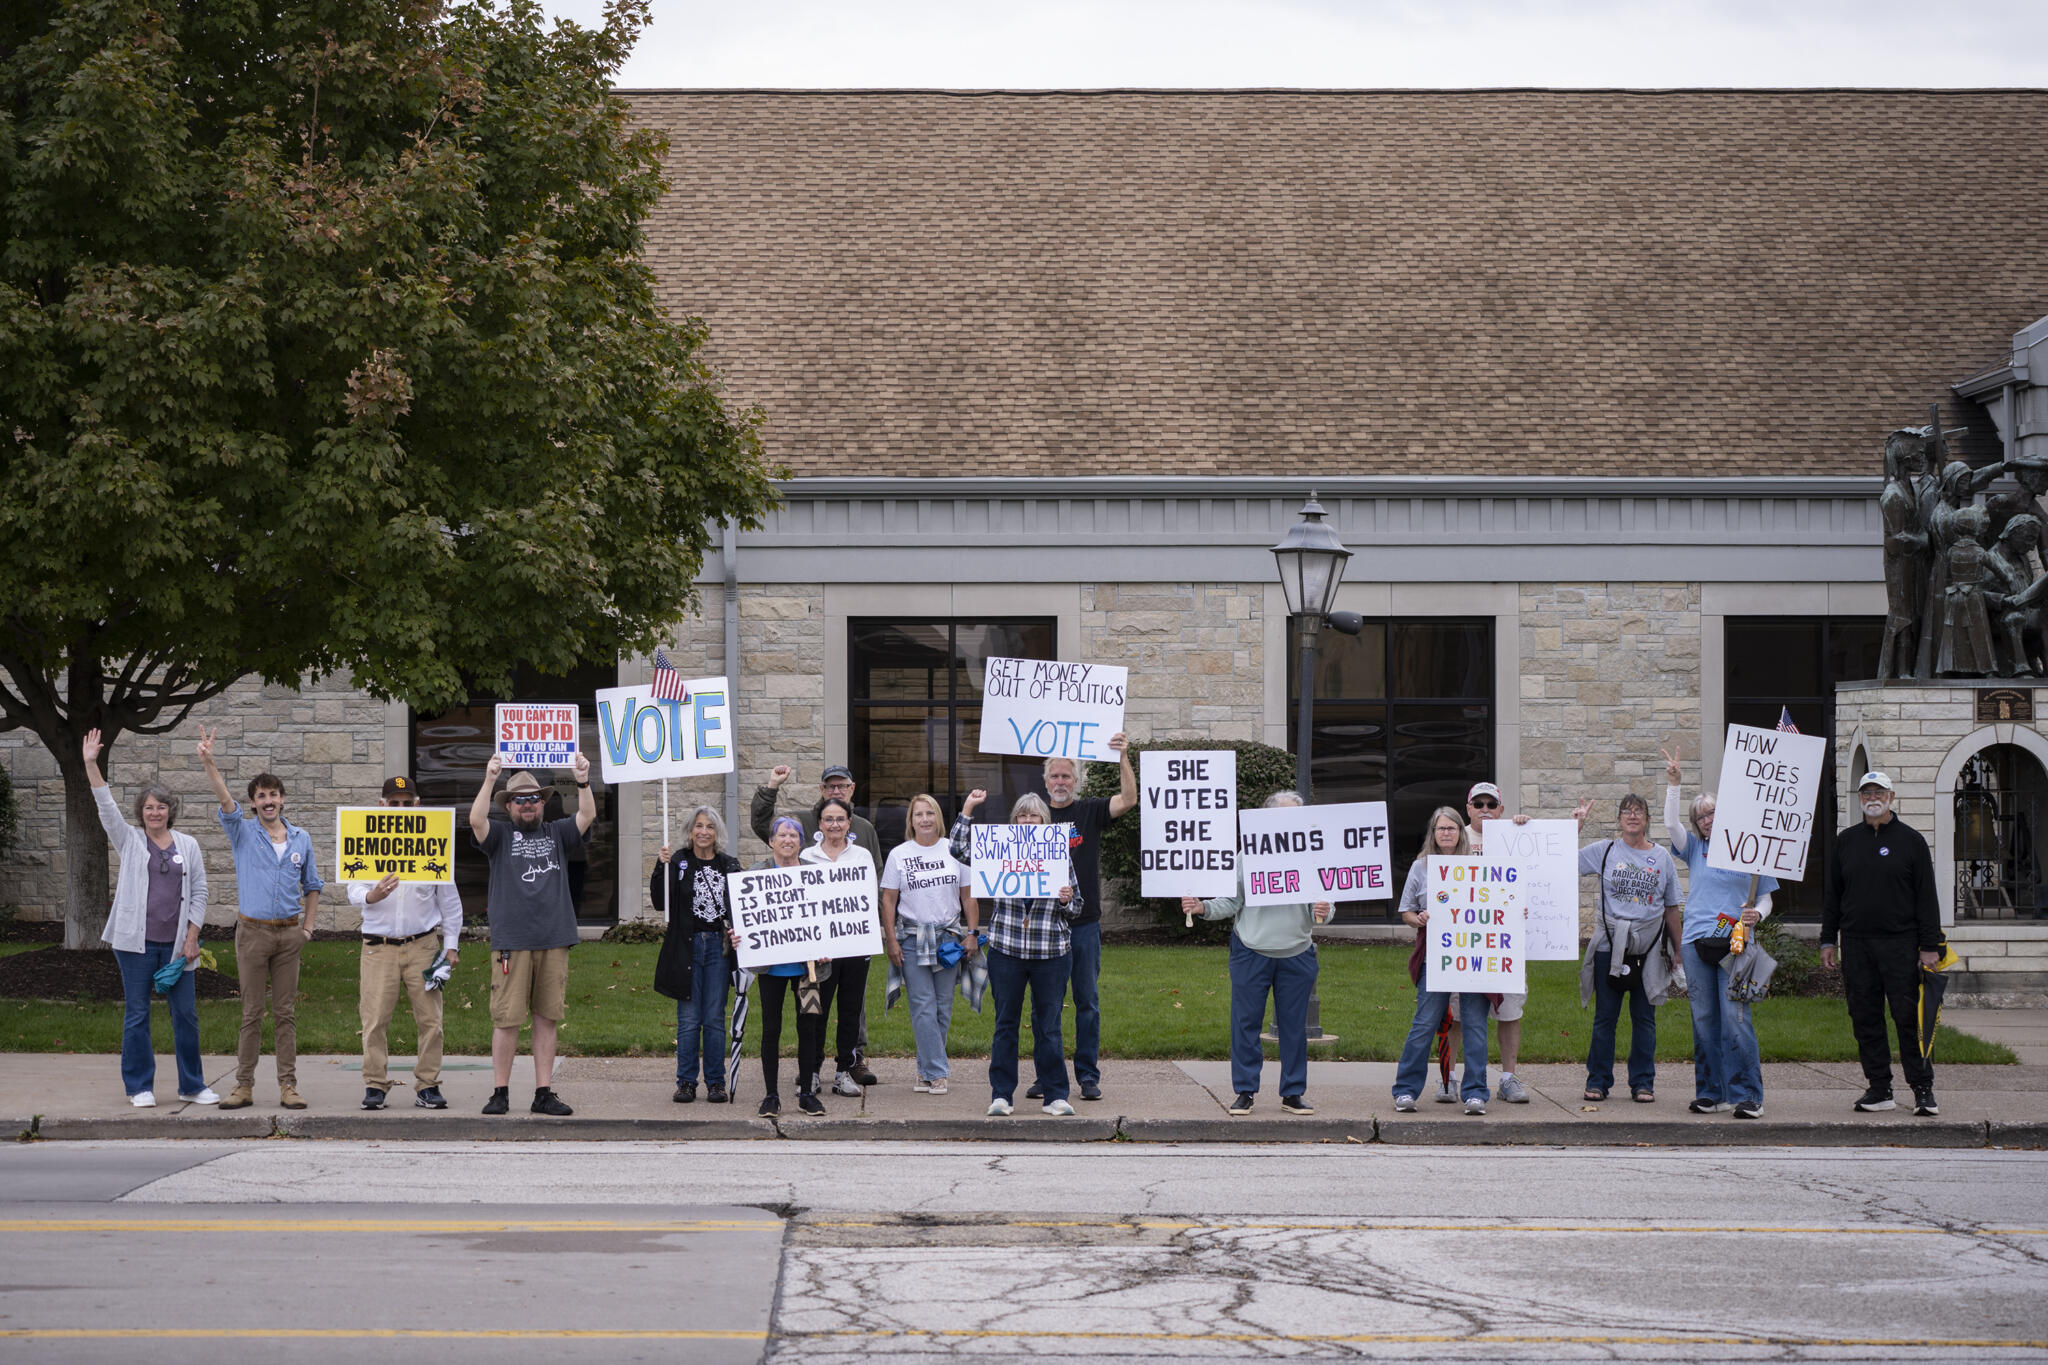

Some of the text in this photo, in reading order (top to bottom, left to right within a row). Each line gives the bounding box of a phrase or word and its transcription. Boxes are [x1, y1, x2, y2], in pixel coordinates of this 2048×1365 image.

[990, 659, 1092, 683] GET MONEY
[988, 676, 1124, 706] OUT OF POLITICS
[503, 709, 572, 722] YOU CAN'T FIX
[501, 722, 573, 741] STUPID
[599, 691, 726, 766] VOTE
[1008, 717, 1099, 759] VOTE
[507, 742, 567, 751] BUT YOU CAN
[1735, 730, 1778, 755] HOW
[537, 753, 546, 763] IT
[549, 753, 569, 763] OUT
[1168, 759, 1209, 781] SHE
[1745, 758, 1800, 784] DOES
[1148, 787, 1228, 810] VOTES
[1753, 782, 1798, 807] THIS
[366, 815, 427, 834] DEFEND
[1761, 808, 1813, 833] END?
[974, 825, 999, 842] WE
[1007, 825, 1038, 843] SINK
[1043, 825, 1067, 842] OR
[1165, 820, 1212, 843] SHE
[1243, 826, 1386, 855] HANDS OFF
[344, 837, 448, 856] DEMOCRACY
[974, 841, 1011, 860] SWIM
[1013, 841, 1068, 860] TOGETHER
[1501, 832, 1562, 857] VOTE
[375, 860, 416, 873] VOTE
[903, 856, 923, 866] THE
[904, 860, 945, 872] BALLOT
[1002, 859, 1045, 873] PLEASE
[1141, 849, 1235, 871] DECIDES
[740, 866, 868, 895] STAND FOR WHAT
[906, 871, 916, 881] IS
[979, 871, 1051, 896] VOTE
[1251, 864, 1384, 895] HER VOTE
[1439, 865, 1517, 883] VOTING
[1618, 886, 1650, 898] DECENCY
[1620, 879, 1653, 890] BY BASIC
[738, 896, 758, 911] IS
[1469, 887, 1490, 903] IS
[742, 895, 870, 928] EVEN IF IT MEANS
[1450, 908, 1505, 925] YOUR
[748, 925, 822, 950] STANDING
[1441, 932, 1512, 949] SUPER
[1441, 956, 1513, 973] POWER
